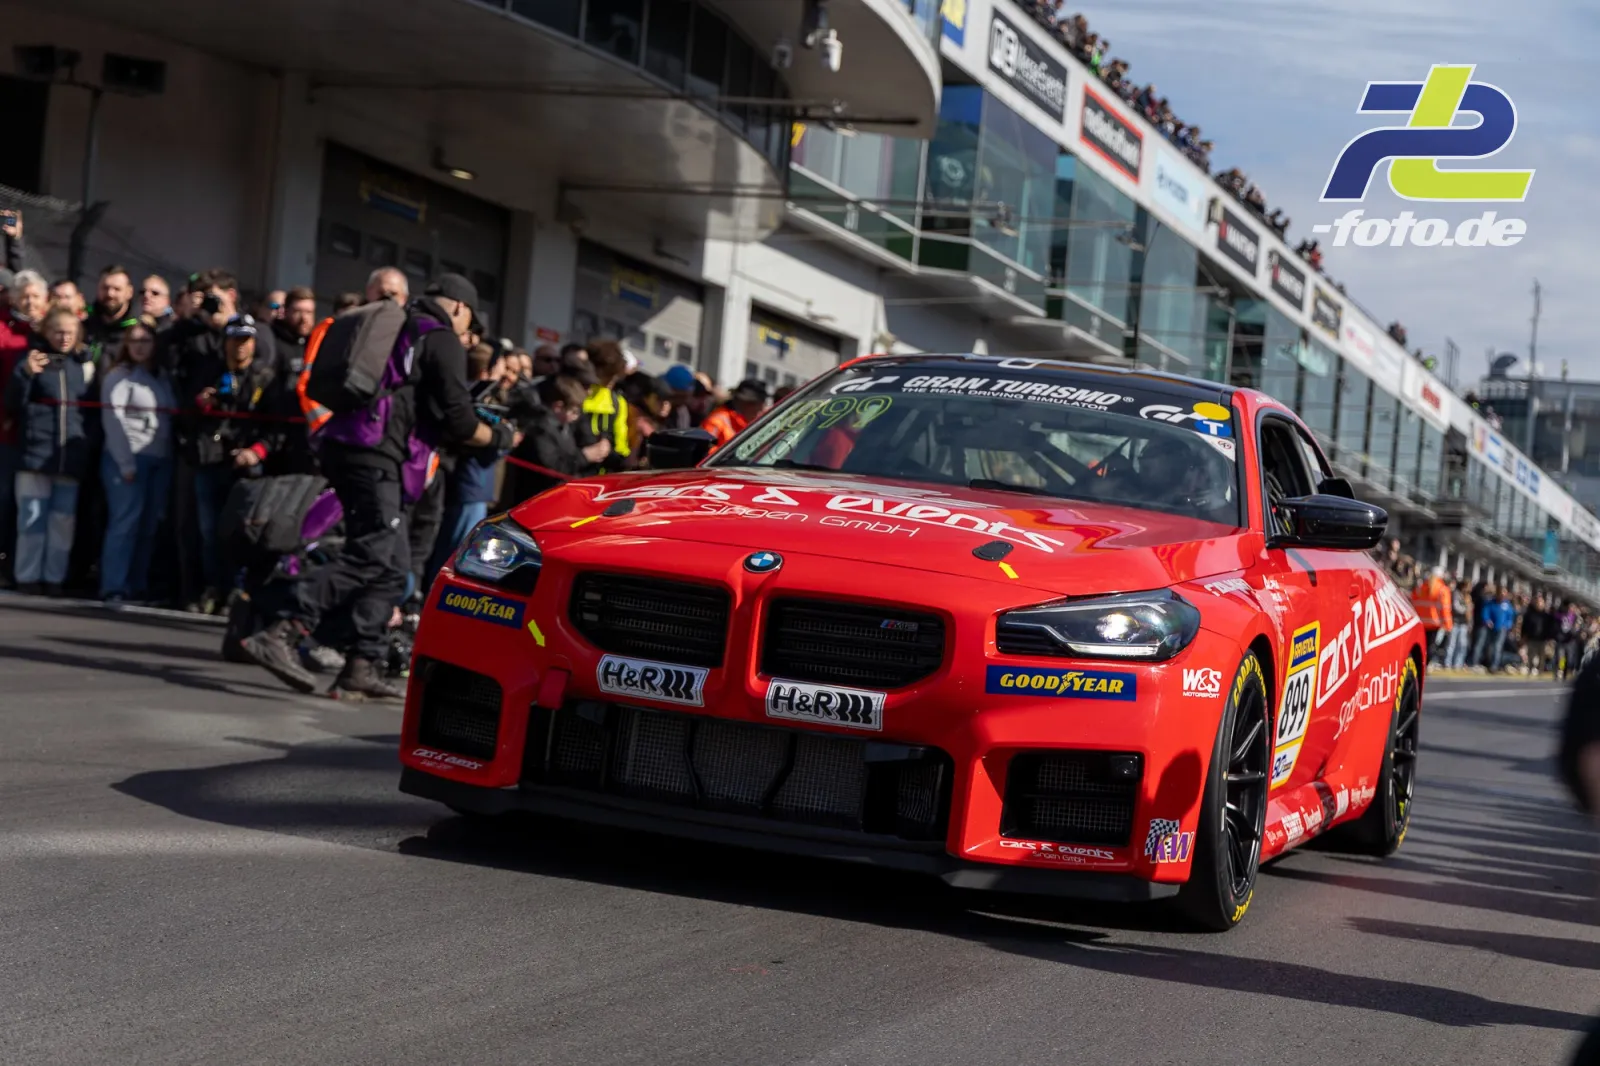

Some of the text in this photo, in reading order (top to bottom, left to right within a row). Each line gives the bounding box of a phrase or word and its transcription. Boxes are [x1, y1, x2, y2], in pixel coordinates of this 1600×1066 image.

[902, 375, 990, 390] GRAN
[901, 386, 1109, 412] THE REAL DRIVING SIMULATOR
[697, 503, 921, 538] Singen GmbH
[825, 494, 1065, 554] events
[1293, 636, 1316, 660] RAVENOL
[602, 660, 662, 695] H&R
[1182, 667, 1223, 693] W&S
[772, 684, 835, 720] H&R
[1182, 691, 1221, 699] MOTORSPORT
[1278, 672, 1310, 740] 899
[999, 840, 1036, 851] cars
[1058, 846, 1114, 861] events
[1032, 850, 1061, 861] Singen
